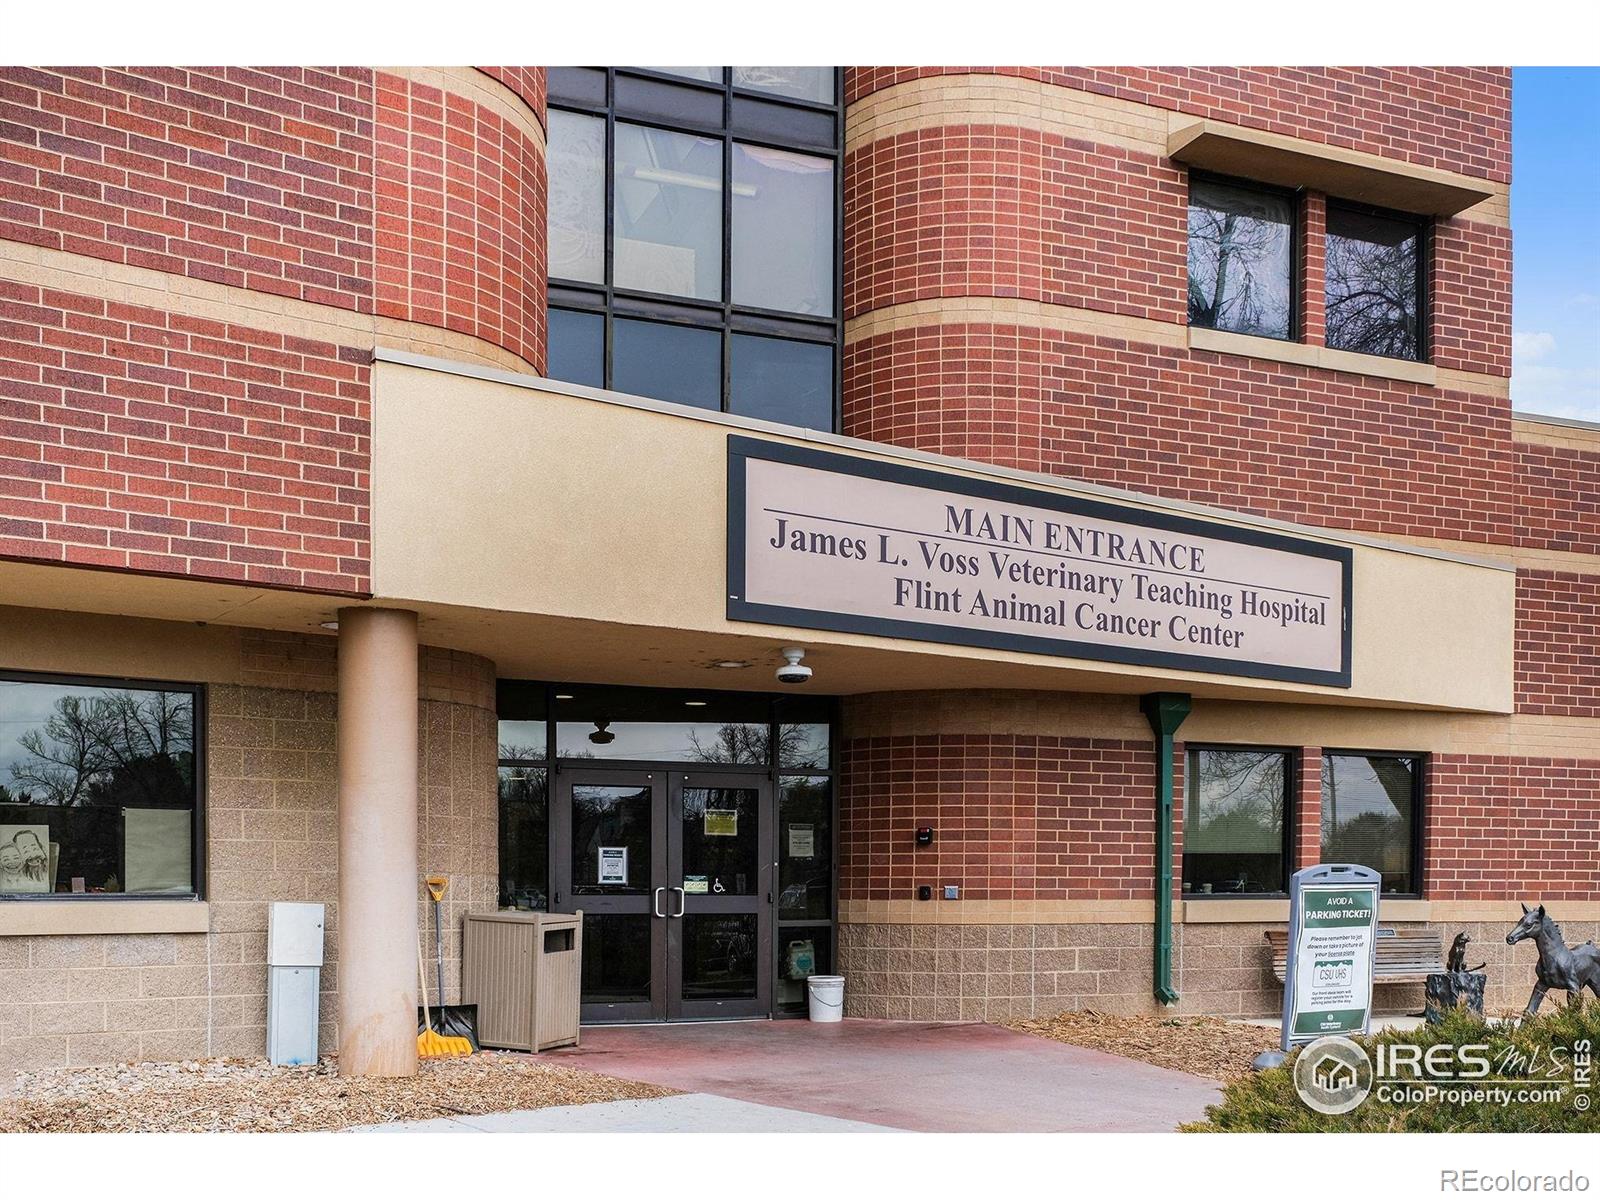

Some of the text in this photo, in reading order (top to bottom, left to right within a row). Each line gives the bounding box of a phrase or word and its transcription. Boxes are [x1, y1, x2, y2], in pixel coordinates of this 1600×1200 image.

[944, 504, 1206, 574] MAIN ENTRANCE
[770, 518, 1326, 628] James L. Voss Veterinary Teaching Hospital
[893, 576, 1245, 649] Flint Animal Cancer Center
[1305, 909, 1371, 919] PARKING TICKET!
[1327, 897, 1353, 905] AVOID A
[1320, 969, 1334, 980] CSU
